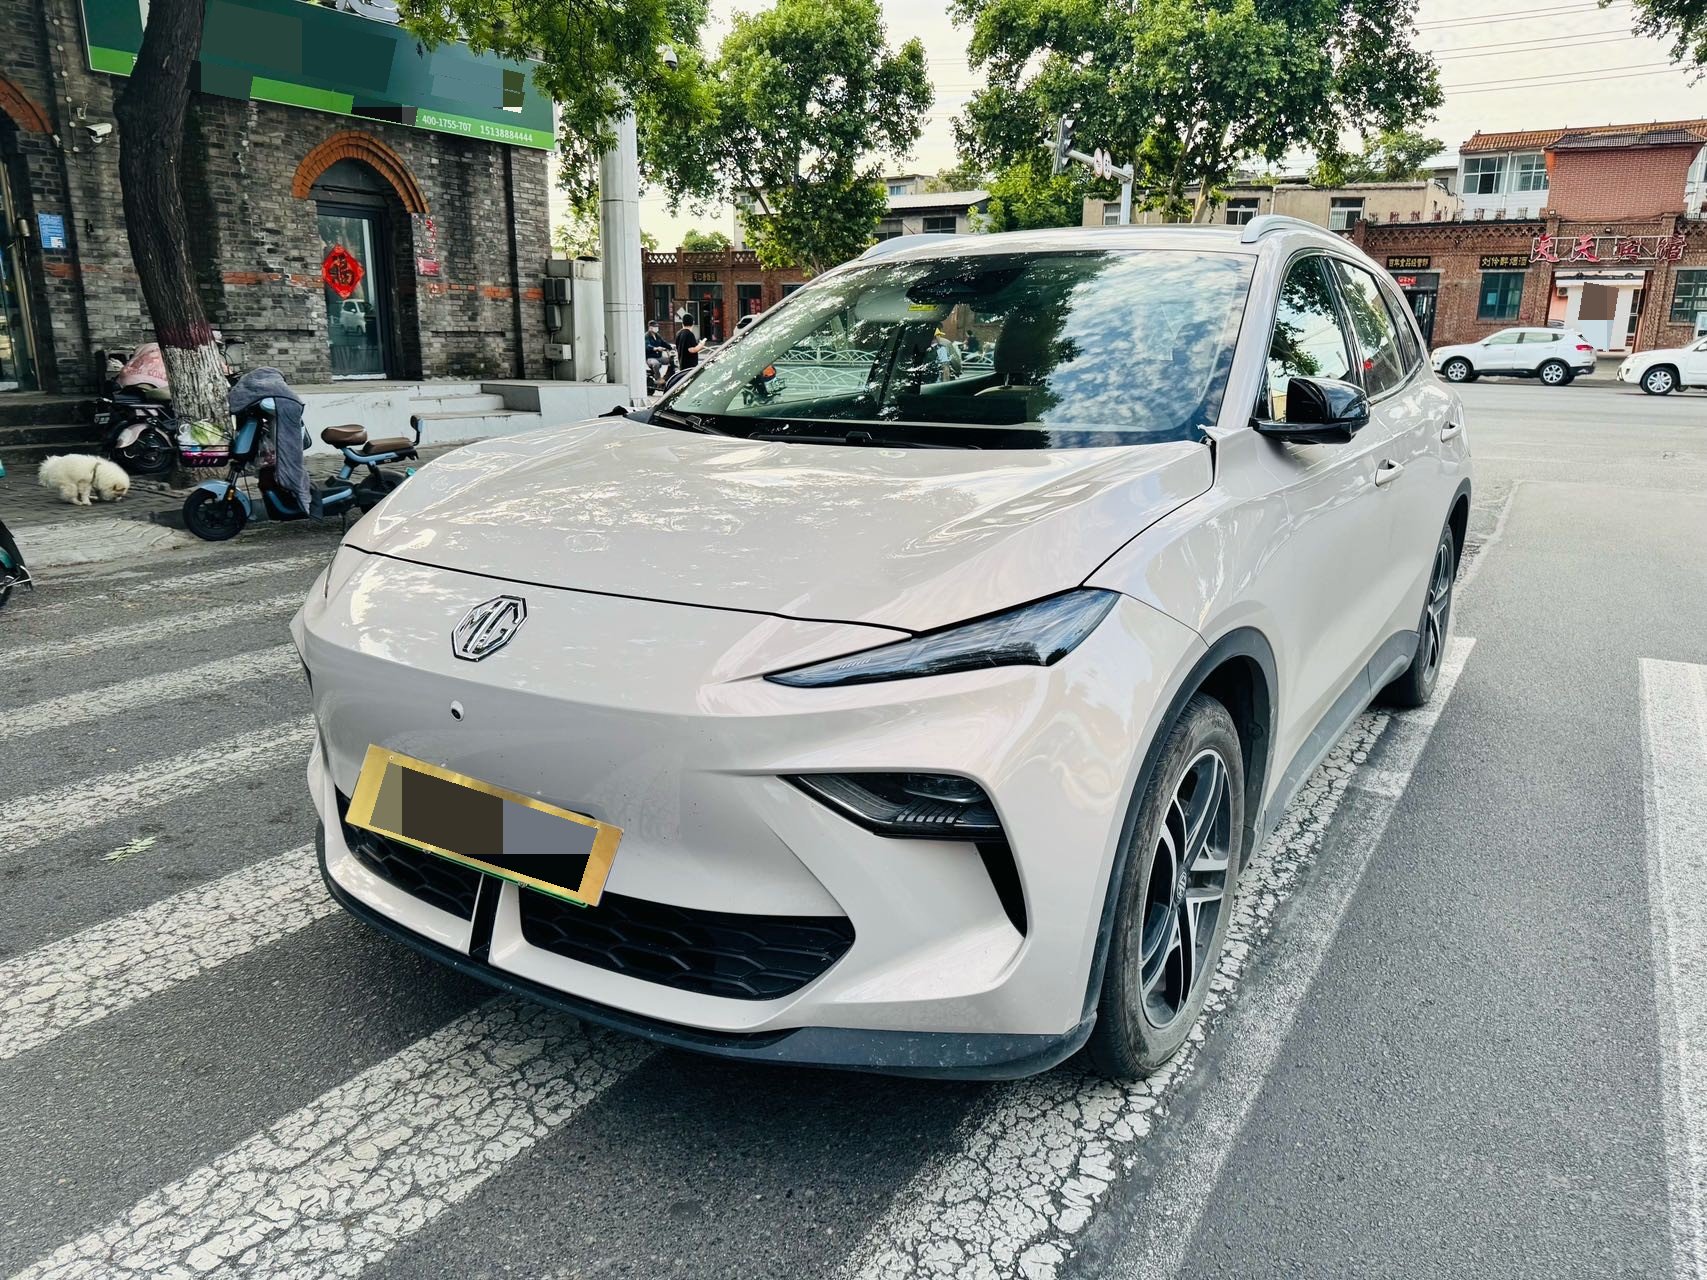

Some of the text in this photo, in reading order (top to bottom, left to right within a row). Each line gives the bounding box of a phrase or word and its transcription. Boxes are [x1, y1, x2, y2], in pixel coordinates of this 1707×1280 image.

[422, 115, 533, 142] 400-1755-707 15138884444
[1529, 233, 1688, 264] 天天宾馆
[329, 254, 355, 287] 福
[456, 598, 523, 658] MG
